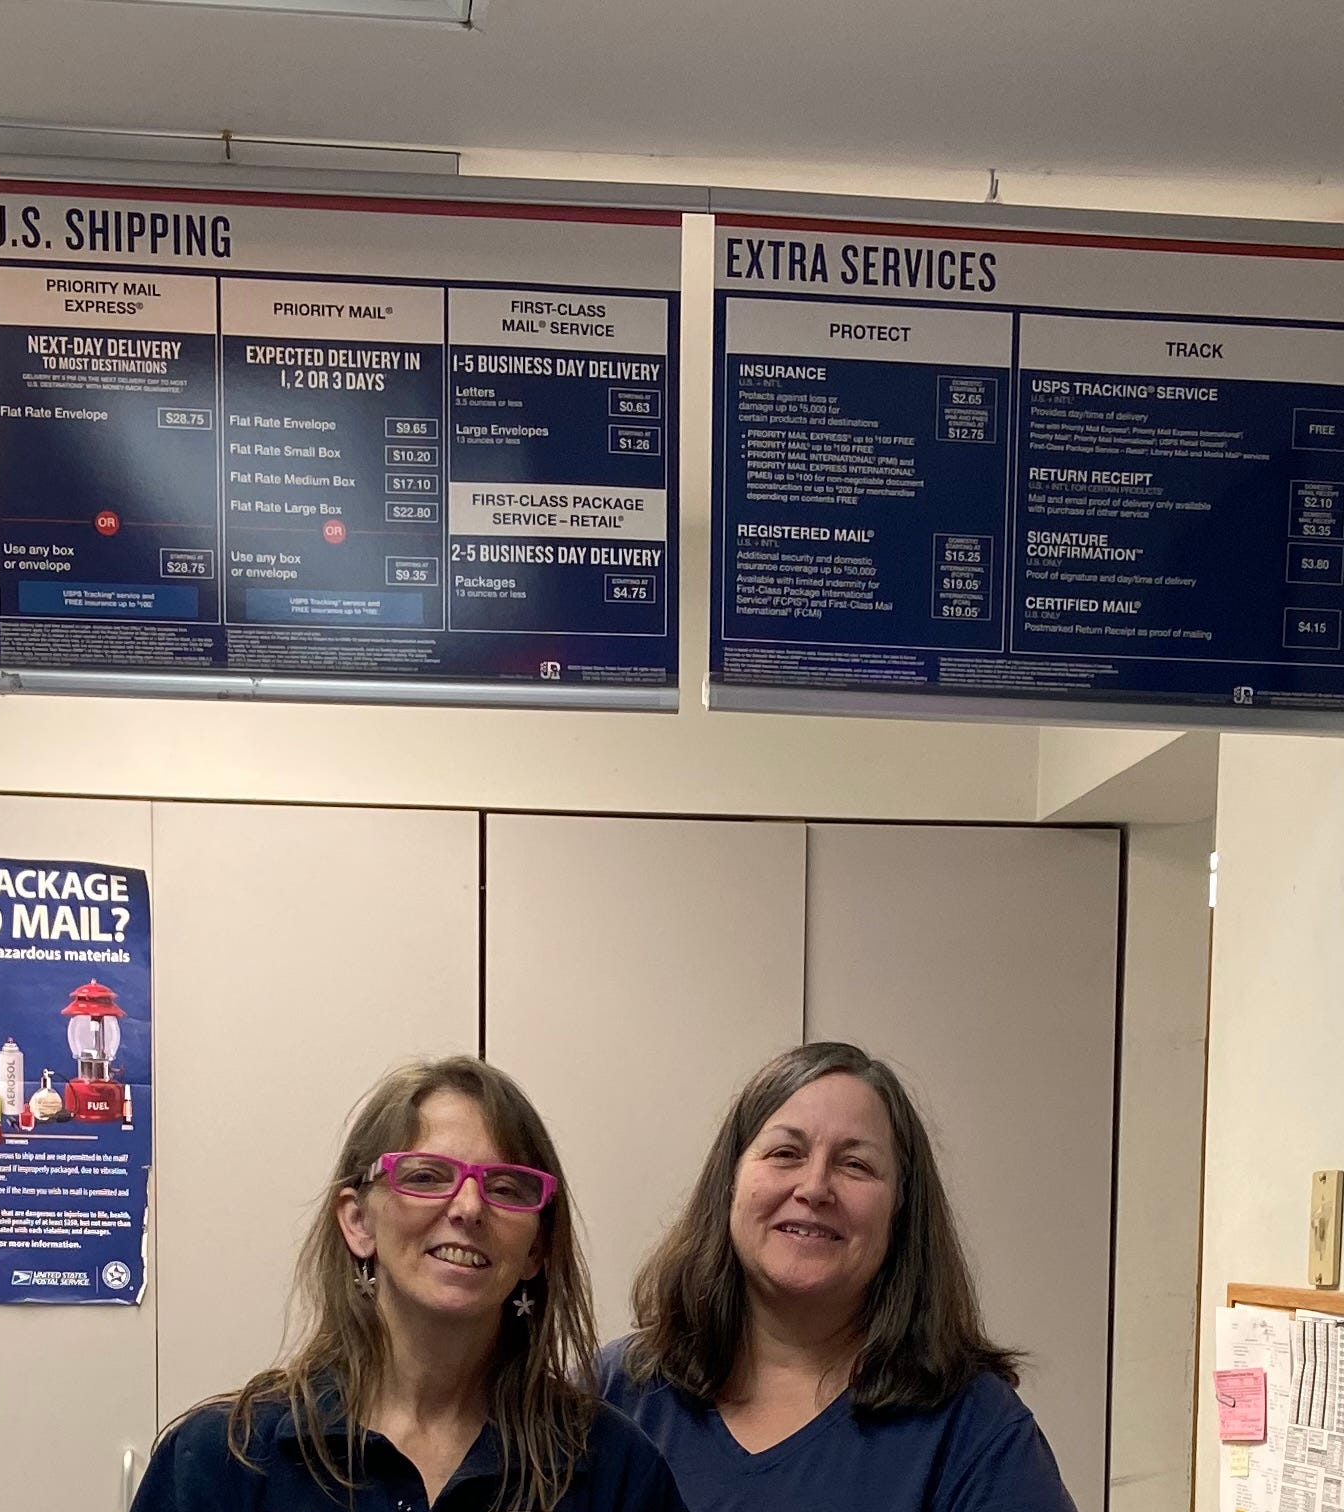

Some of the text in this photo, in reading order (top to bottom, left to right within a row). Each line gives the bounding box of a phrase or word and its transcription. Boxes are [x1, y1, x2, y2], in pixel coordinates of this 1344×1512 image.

[65, 208, 231, 258] SHIPPING
[726, 238, 997, 293] EXTRA SERVICES
[46, 279, 161, 296] PRIORITY MAIL
[273, 303, 344, 317] PRIORITY
[830, 323, 911, 342] PROTECT
[28, 335, 182, 359] NEXT-DAY DELIVERY
[1165, 341, 1224, 358] TRACK
[43, 357, 167, 374] TO MOST DESTINATIONS
[246, 345, 420, 370] EXPECTED DELIVERY IN
[739, 364, 826, 381] INSURANCE
[1032, 379, 1070, 394] USPS
[1156, 386, 1218, 401] SERVICE
[952, 393, 982, 406] $2.65
[0, 406, 108, 422] Flat Rate Envelope
[165, 412, 204, 425] $28.75
[1308, 423, 1335, 435] FREE
[1029, 467, 1153, 486] RETURN RECEIPT
[472, 494, 644, 512] FIRST-CLASS PACKAGE
[492, 513, 557, 526] SERVICE
[738, 524, 830, 540] REGISTERED
[1027, 531, 1108, 547] SIGNATURE
[452, 544, 661, 567] 2-5 BUSINESS DAY DELIVERY
[455, 575, 516, 590] Packages
[613, 587, 647, 599] $4.75
[12, 904, 130, 942] MAIL?
[64, 948, 130, 963] materials
[8, 1060, 16, 1107] AEROSOL
[87, 1101, 110, 1110] FUEL
